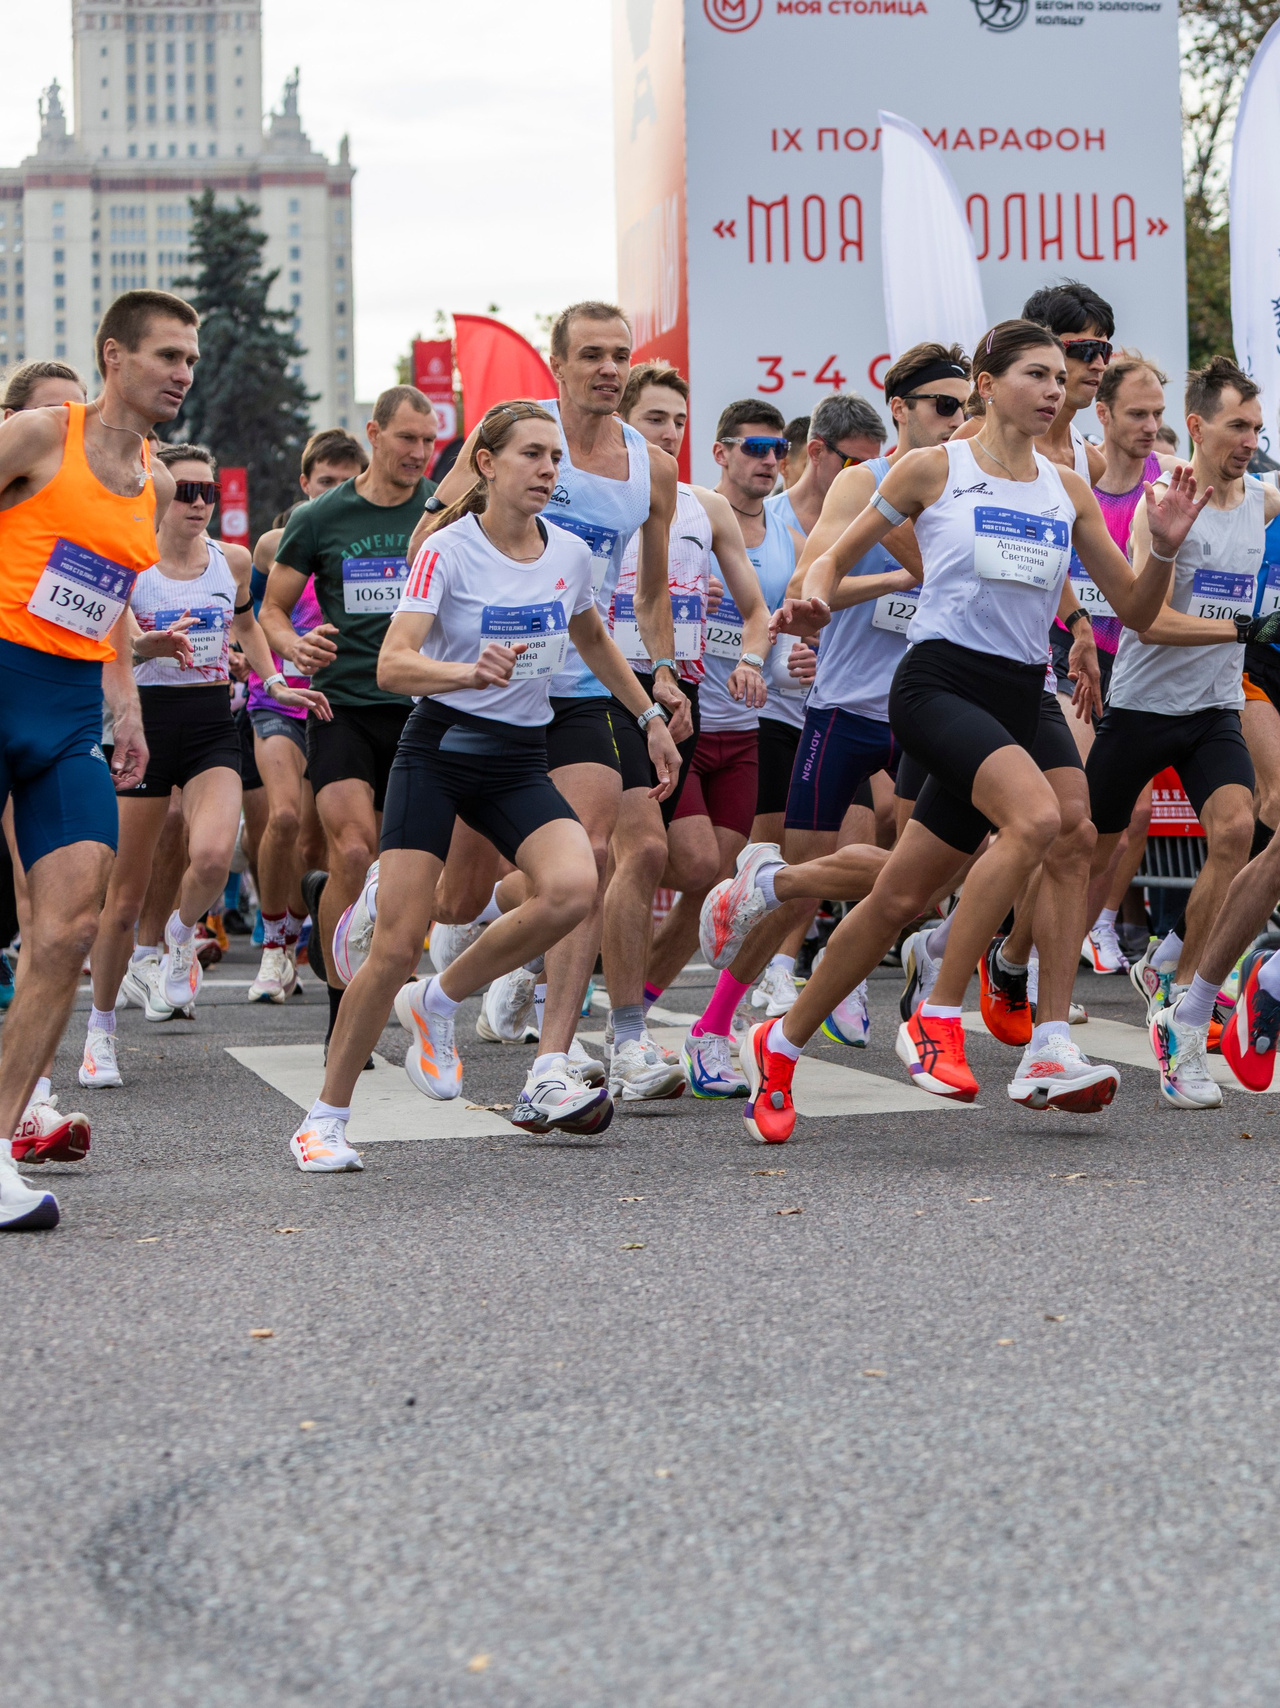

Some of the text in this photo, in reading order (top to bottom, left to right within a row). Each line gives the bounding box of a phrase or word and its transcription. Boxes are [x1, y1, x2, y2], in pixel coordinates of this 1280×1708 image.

[777, 0, 929, 17] МОЯ СТОЛИЦА
[1035, 16, 1085, 26] КОЛЬЦУ
[771, 127, 1105, 152] IX ПОЛМАРАФОН
[965, 192, 1170, 261] ОЛИЦА»
[755, 353, 847, 393] 3-4
[341, 533, 411, 560] ADVENT
[997, 540, 1049, 557] Аплачкина
[1001, 551, 1045, 567] Светлана
[355, 587, 401, 602] 10631
[1078, 588, 1107, 603] 130
[49, 585, 107, 622] 13948
[887, 601, 917, 620] 122
[189, 634, 216, 643] енева
[706, 626, 742, 647] 1228
[193, 644, 209, 653] фья
